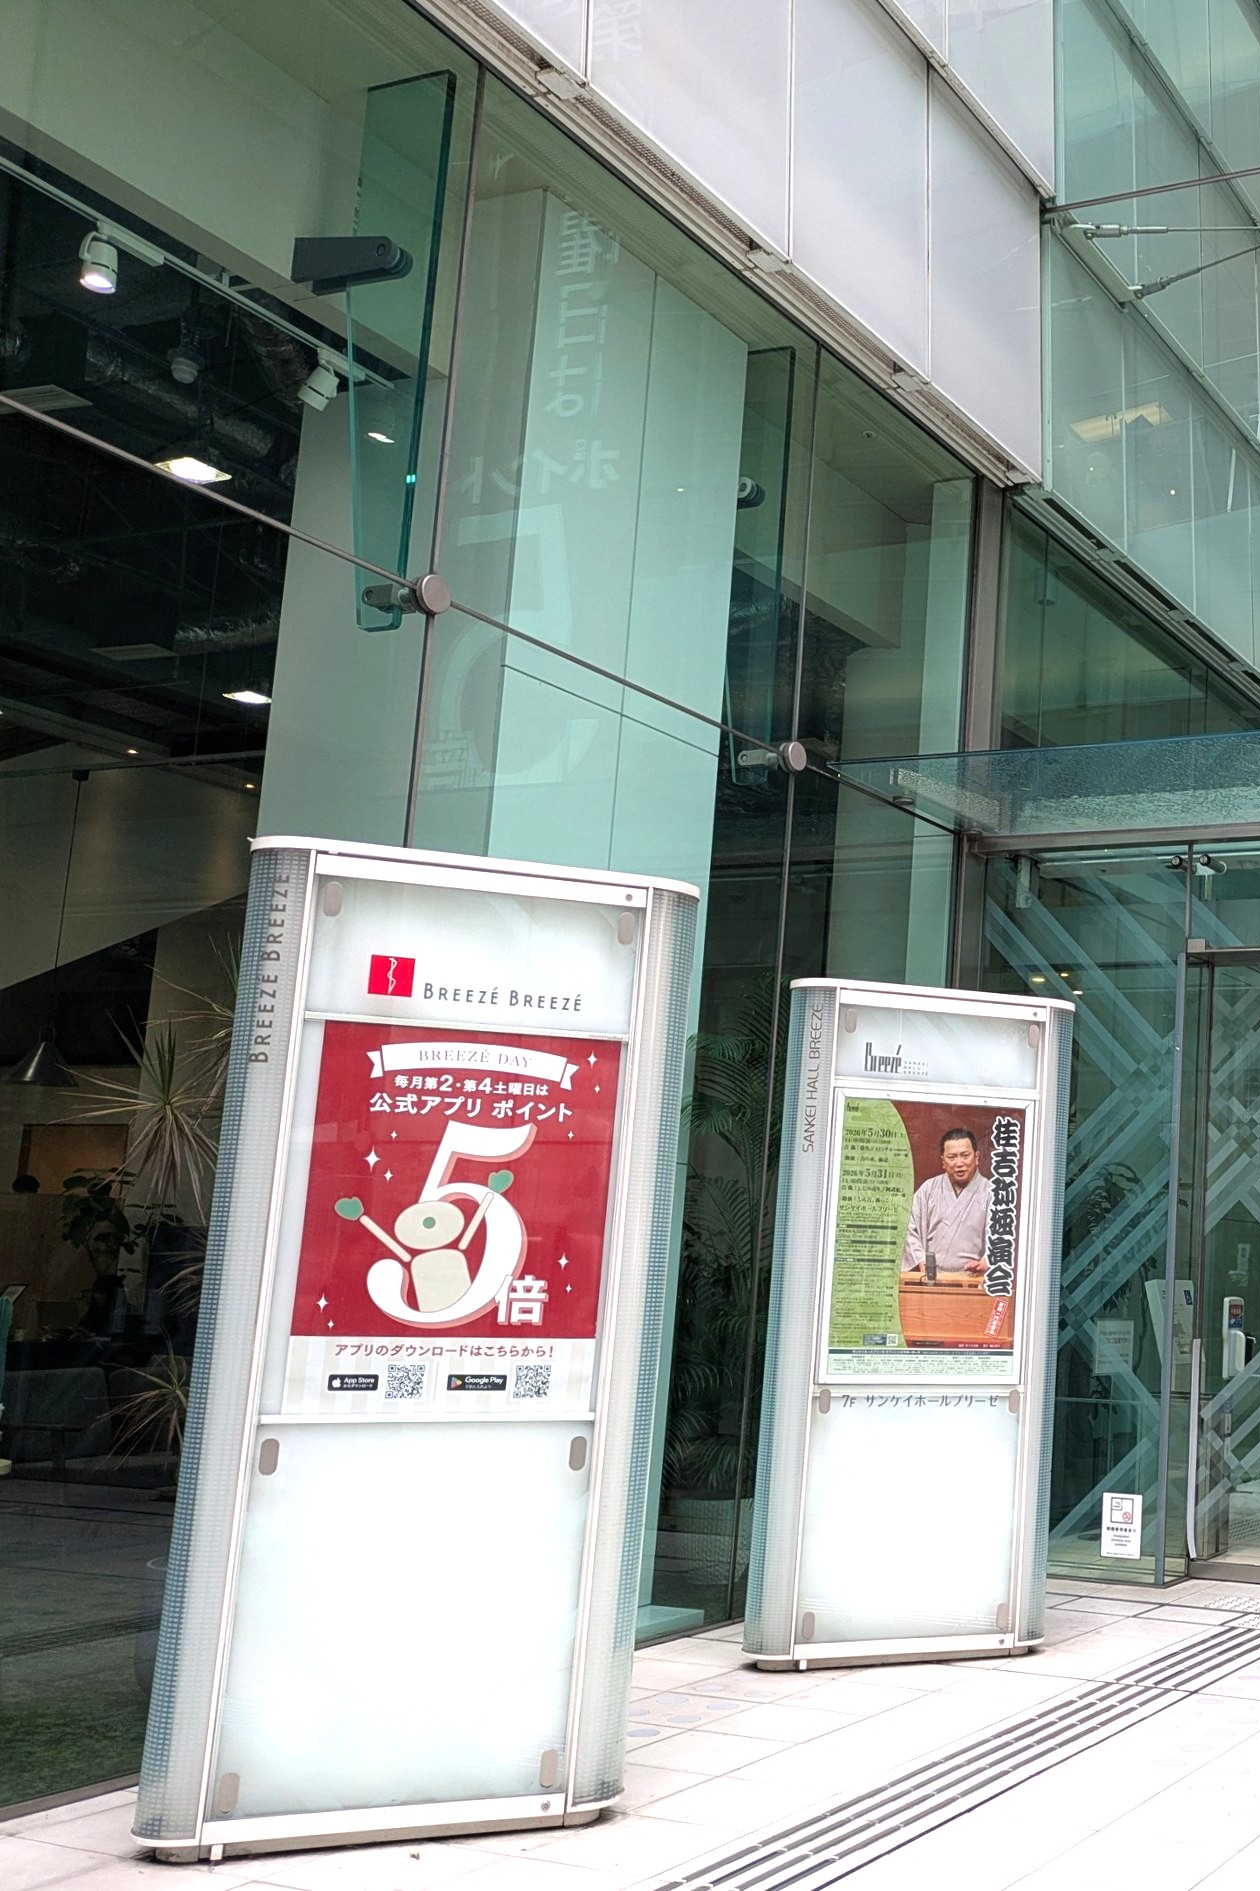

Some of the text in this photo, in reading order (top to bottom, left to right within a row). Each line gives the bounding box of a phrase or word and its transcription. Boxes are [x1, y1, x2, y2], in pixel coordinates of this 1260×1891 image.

[423, 982, 582, 1012] BREEZÉ BREEZÉ
[498, 1053, 532, 1068] DAY
[805, 1063, 819, 1100] HALL
[369, 1092, 573, 1123] 公式アプリ ポイント
[802, 1104, 817, 1153] SANKEI
[465, 1376, 504, 1385] Google Play
[841, 1394, 1000, 1408] 7F サンケイホールブリーゼ
